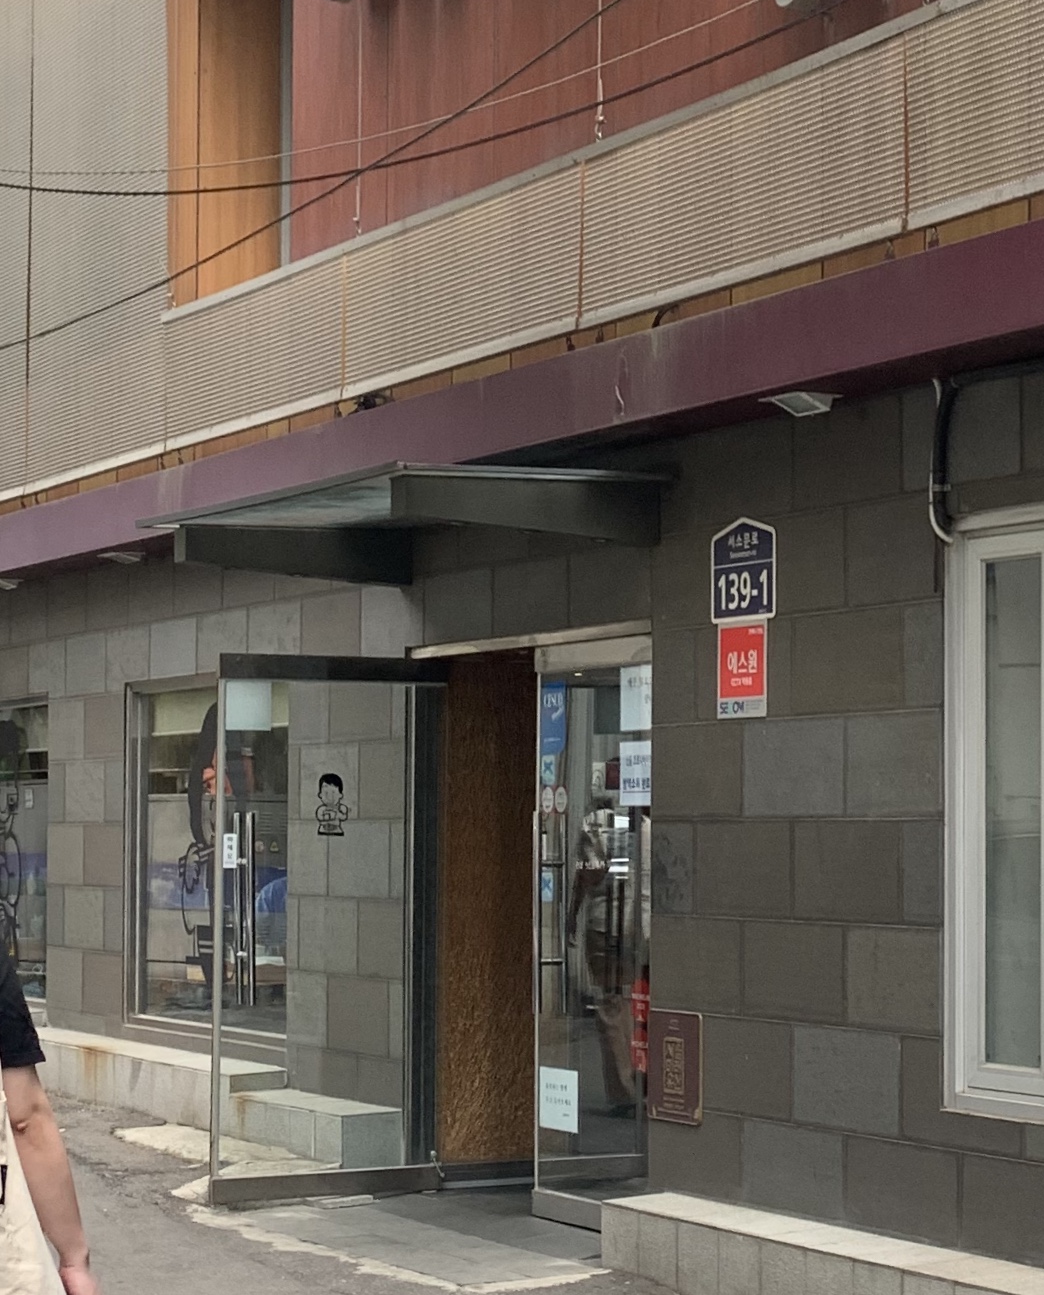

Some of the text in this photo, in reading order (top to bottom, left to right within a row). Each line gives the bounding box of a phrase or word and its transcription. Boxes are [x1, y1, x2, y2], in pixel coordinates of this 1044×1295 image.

[728, 530, 759, 549] 서소문로
[718, 568, 768, 611] 139-1
[727, 649, 757, 674] 에스원
